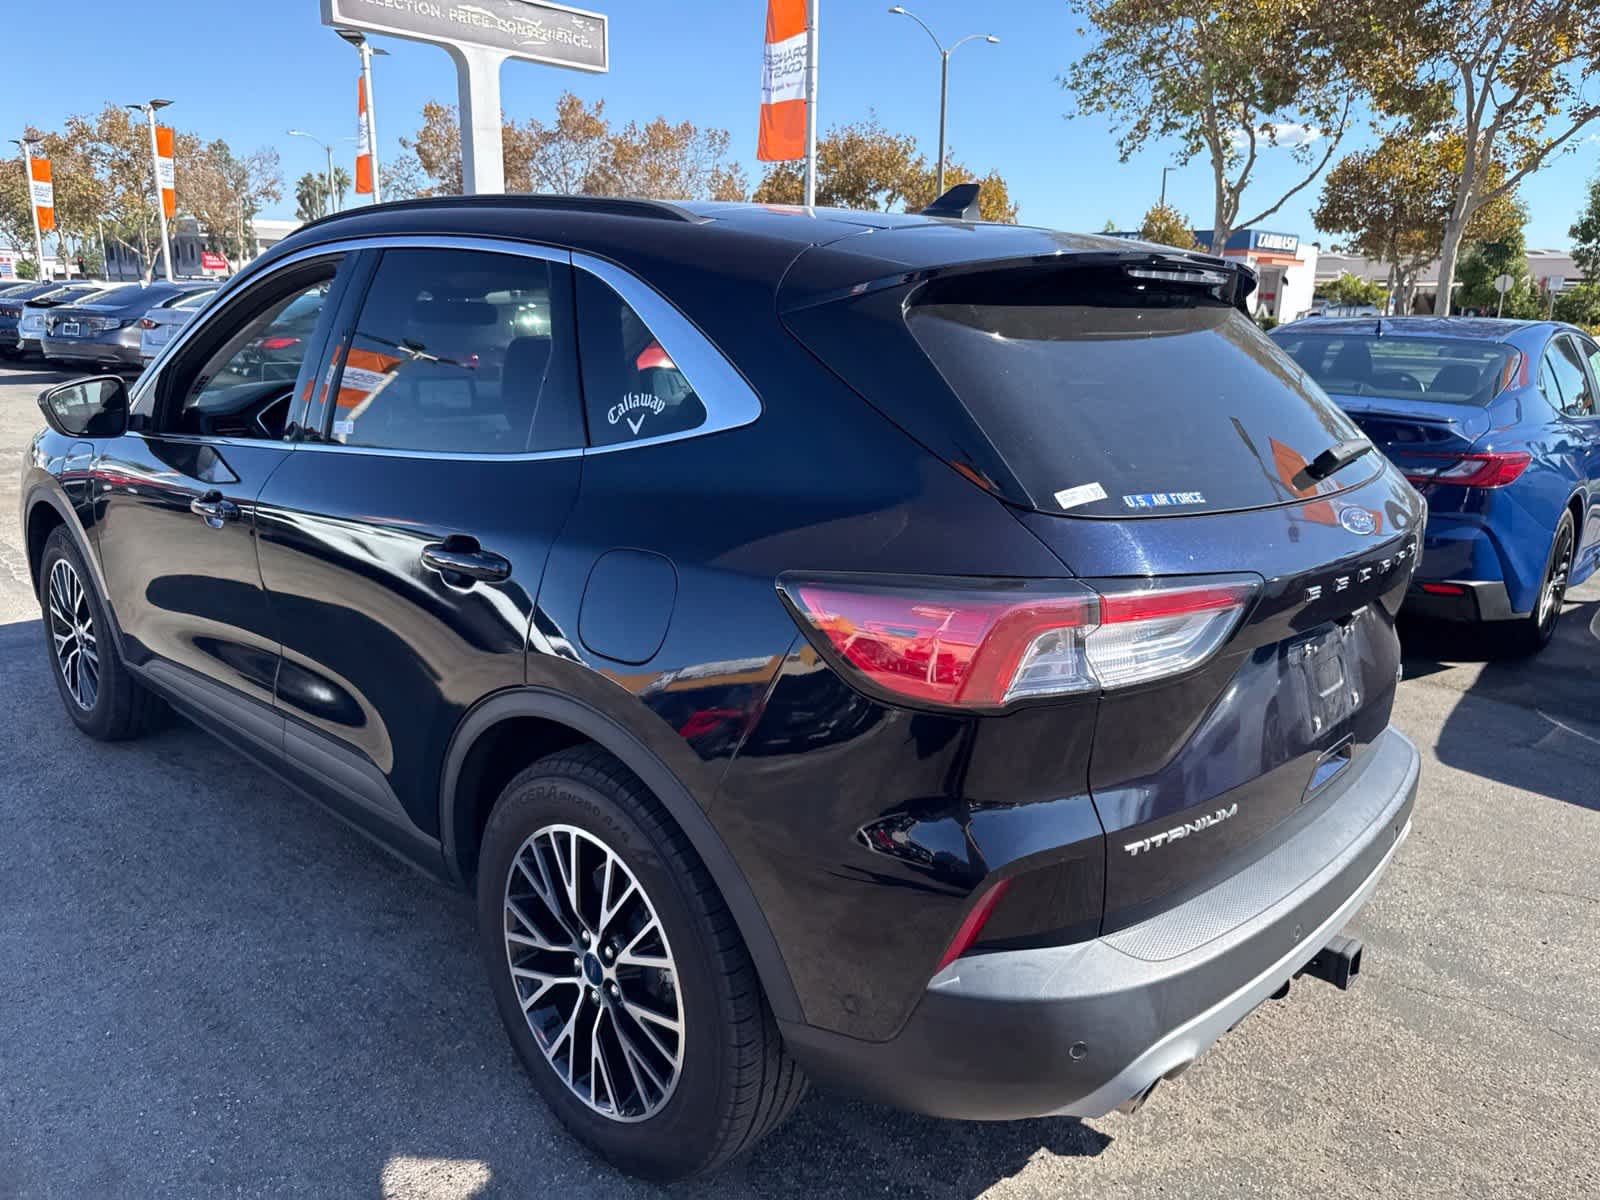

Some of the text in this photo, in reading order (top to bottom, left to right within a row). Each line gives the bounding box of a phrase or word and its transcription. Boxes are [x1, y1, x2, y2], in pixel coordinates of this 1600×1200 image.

[607, 391, 666, 425] Callaway
[1122, 494, 1150, 508] U.S.
[1151, 493, 1170, 506] AIR
[1170, 491, 1207, 505] FORCE
[1123, 803, 1238, 857] TITANIUM
